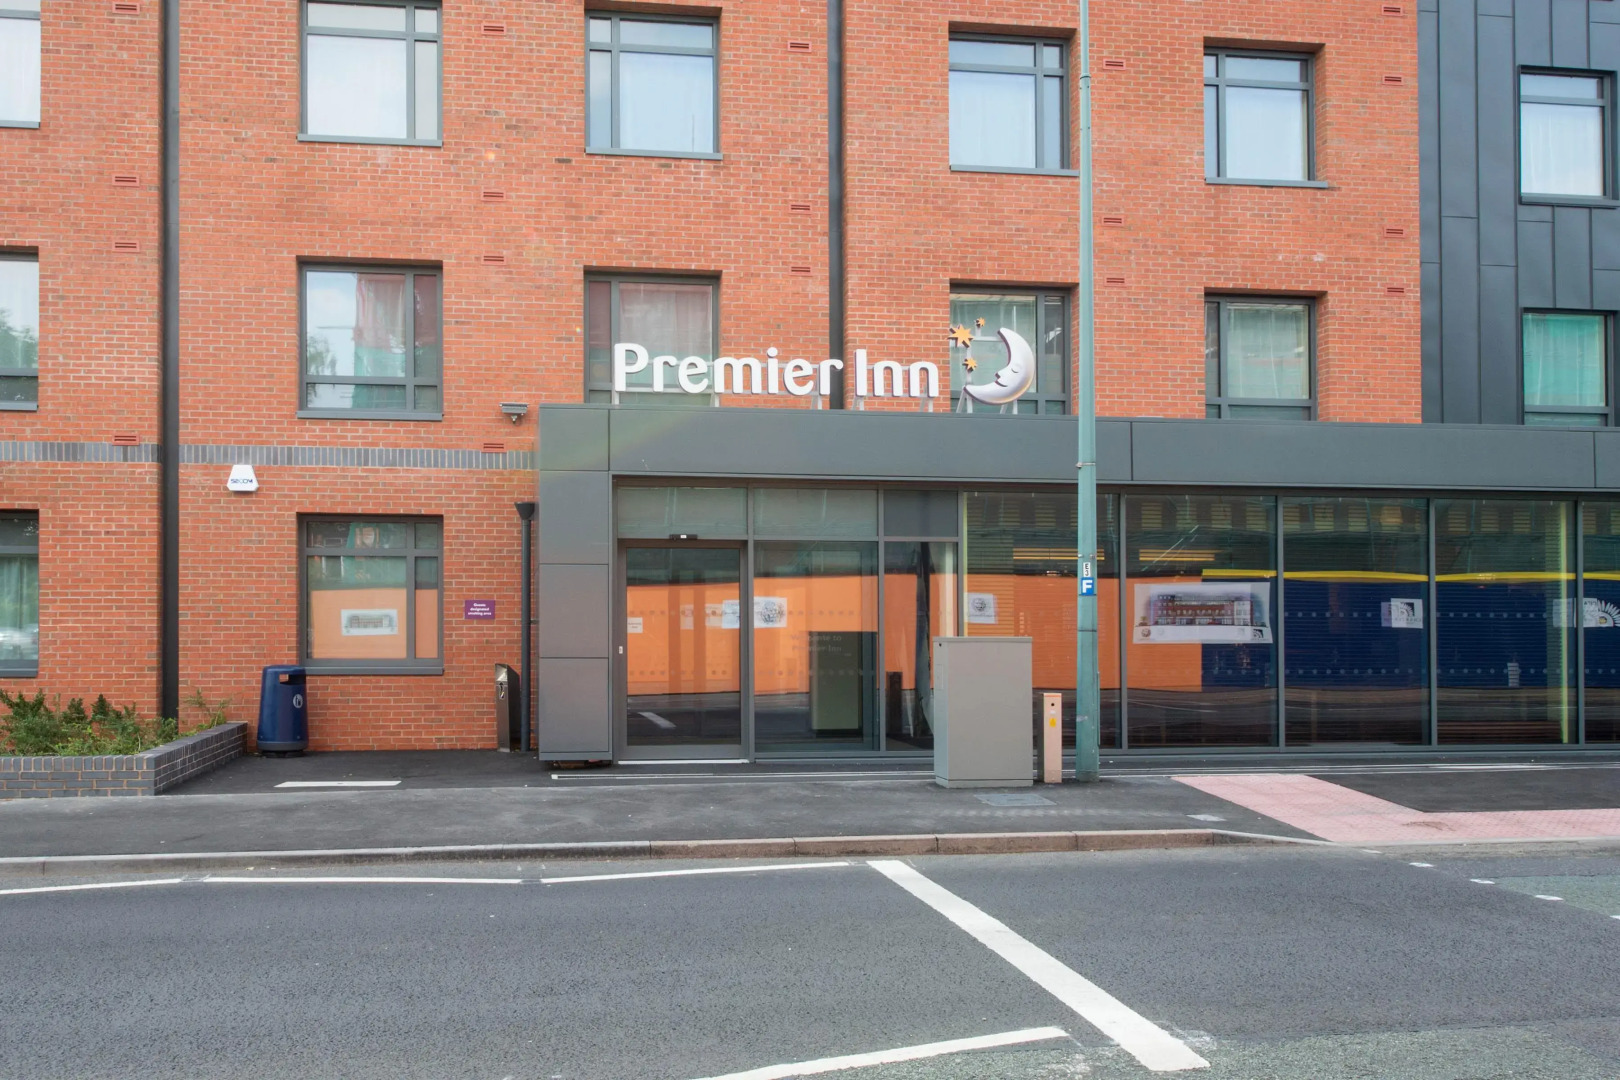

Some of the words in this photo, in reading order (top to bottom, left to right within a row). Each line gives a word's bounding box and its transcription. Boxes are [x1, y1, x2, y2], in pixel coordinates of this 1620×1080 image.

[614, 343, 843, 396] Premier
[854, 349, 938, 397] Inn
[1082, 580, 1093, 593] F
